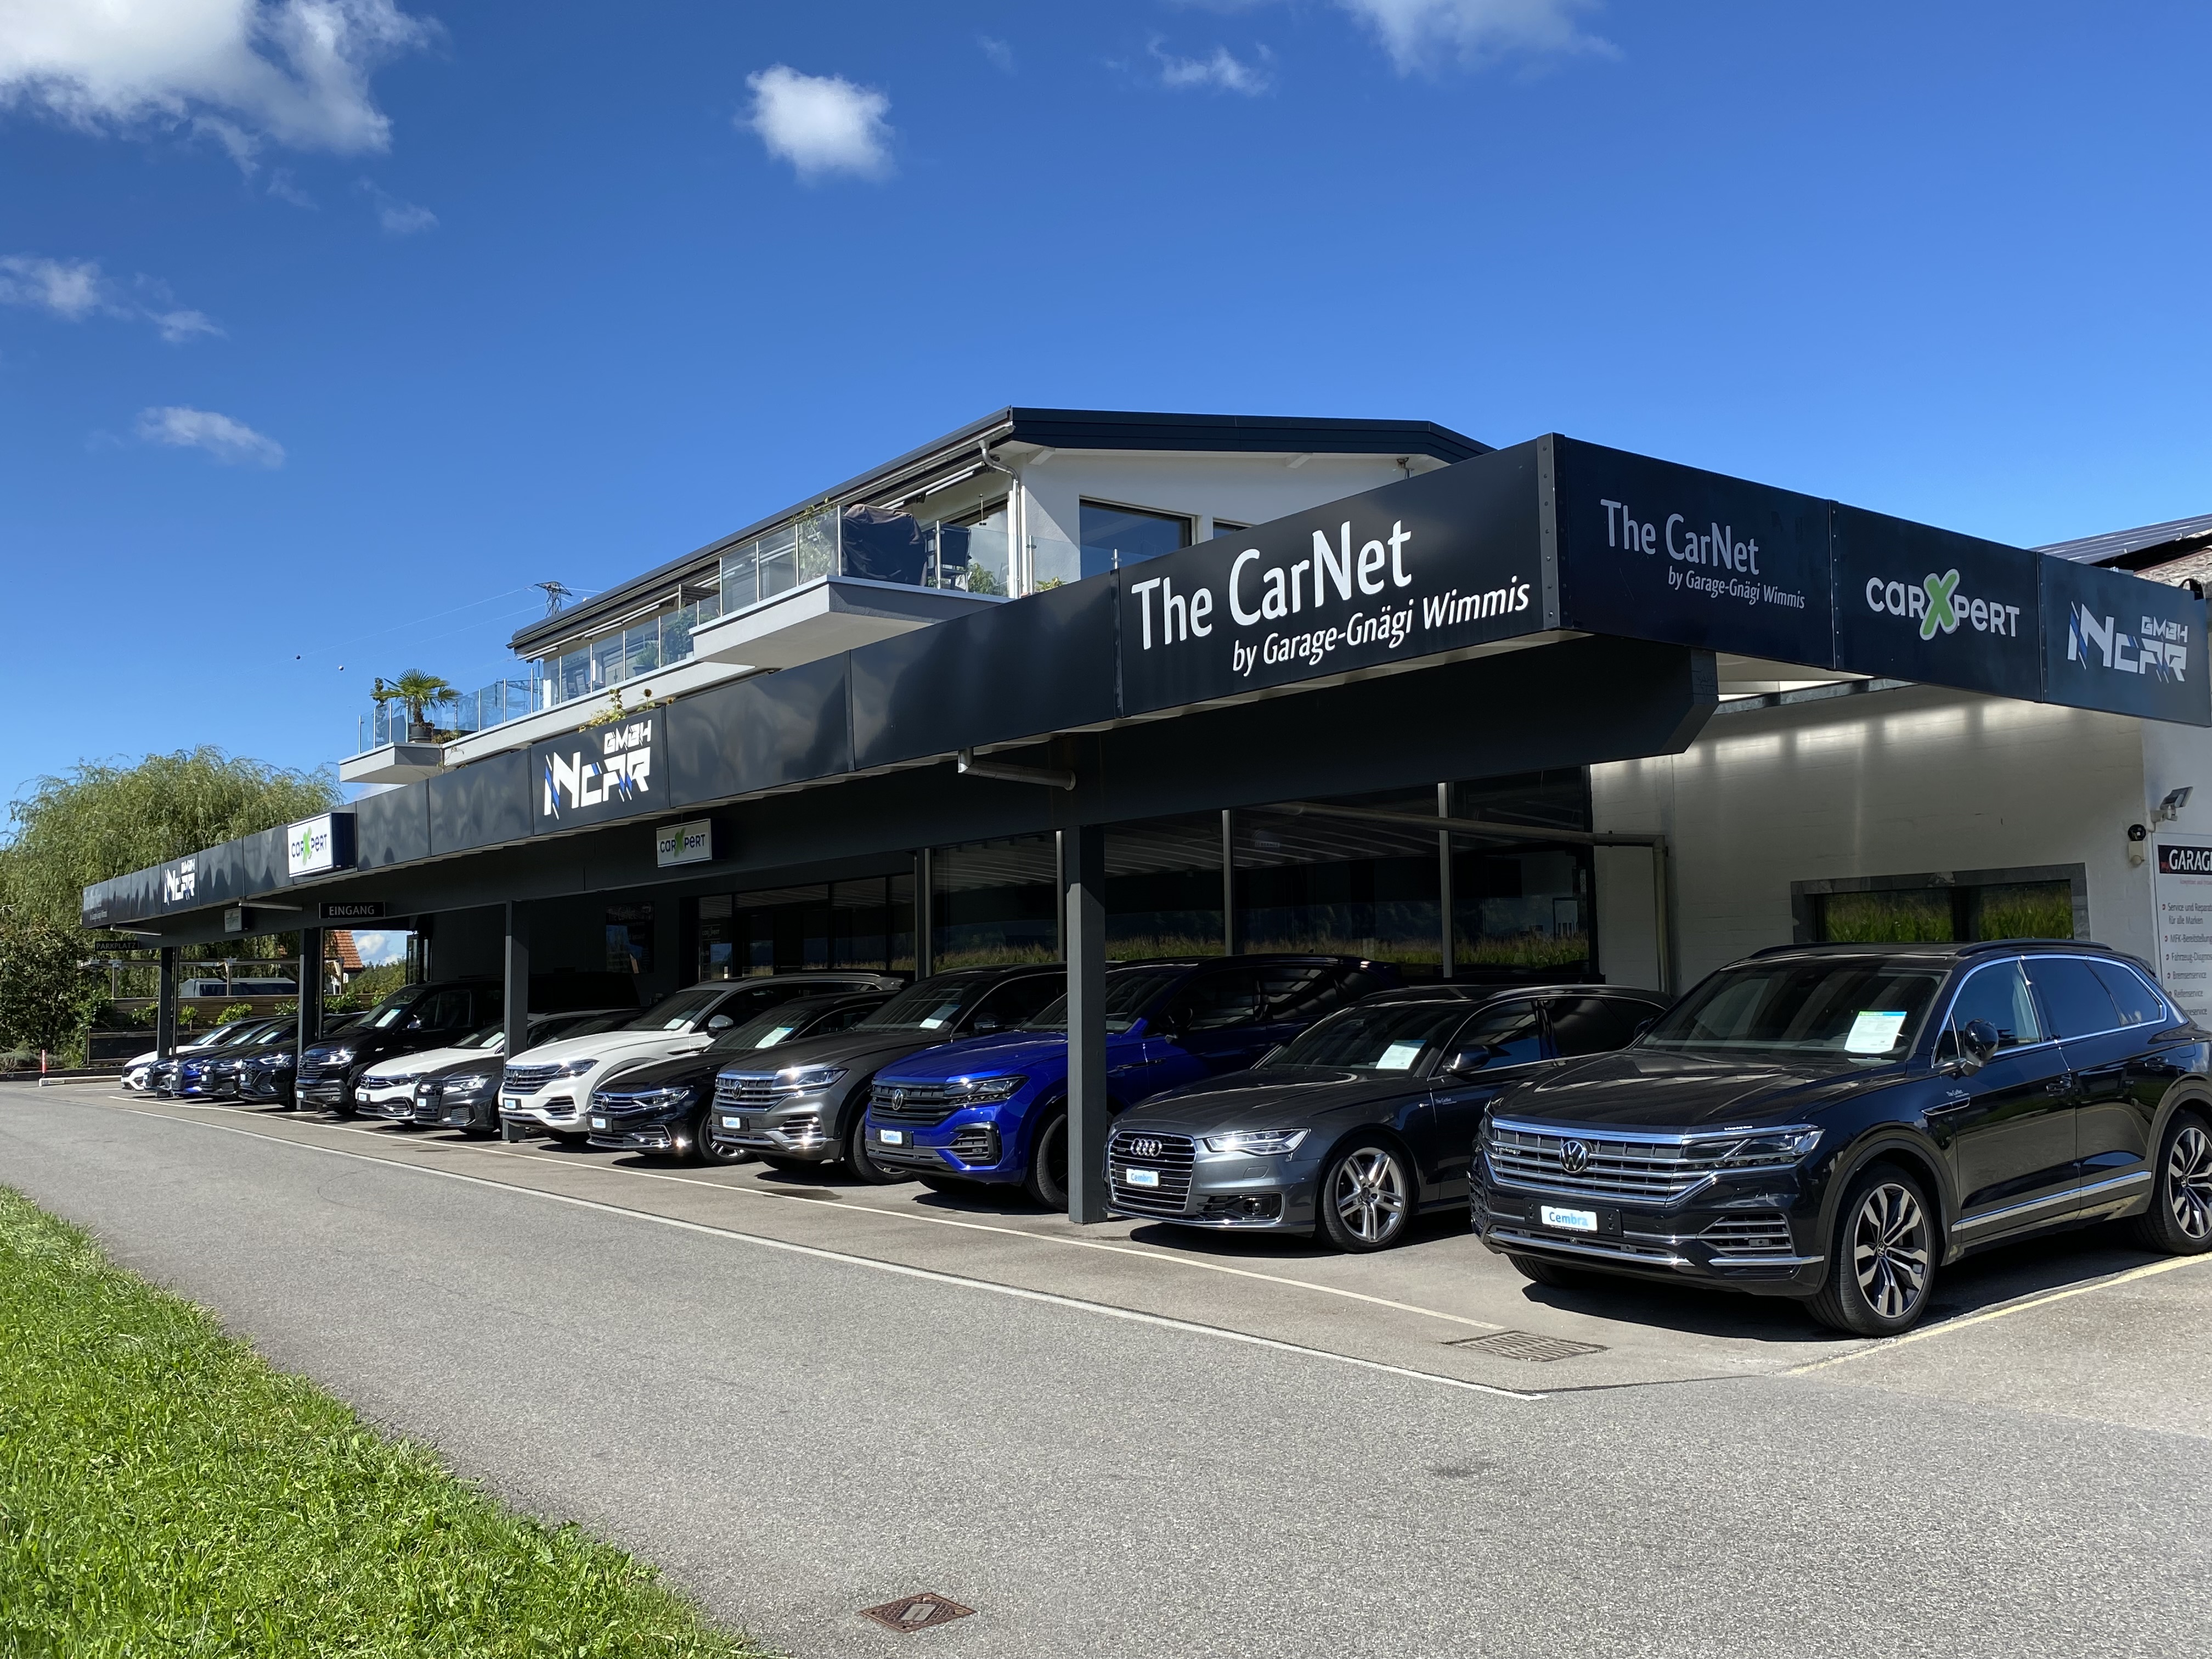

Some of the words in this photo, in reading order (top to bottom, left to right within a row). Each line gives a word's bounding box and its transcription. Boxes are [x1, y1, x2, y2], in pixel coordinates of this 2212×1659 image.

[1600, 499, 1656, 555] The
[1666, 514, 1760, 575] CarNet
[1131, 577, 1212, 650] The
[1228, 520, 1412, 626] CarNet
[1668, 566, 1683, 590] by
[1686, 571, 1760, 605] Garage-Gnägi
[1763, 584, 1805, 610] Wimmis
[1233, 639, 1257, 676] by
[1263, 599, 1414, 665] Garage-Gnägi
[1422, 575, 1530, 629] Wimmis
[2169, 849, 2212, 871] GARAG
[329, 905, 375, 916] EINGANG
[2168, 902, 2184, 911] Service
[2185, 902, 2194, 911] und
[2176, 915, 2185, 924] alle
[2186, 916, 2203, 924] Marken
[2172, 971, 2207, 980] Bremsenservice
[2174, 989, 2203, 998] Reifenservice
[1549, 1211, 1588, 1227] Cembra
